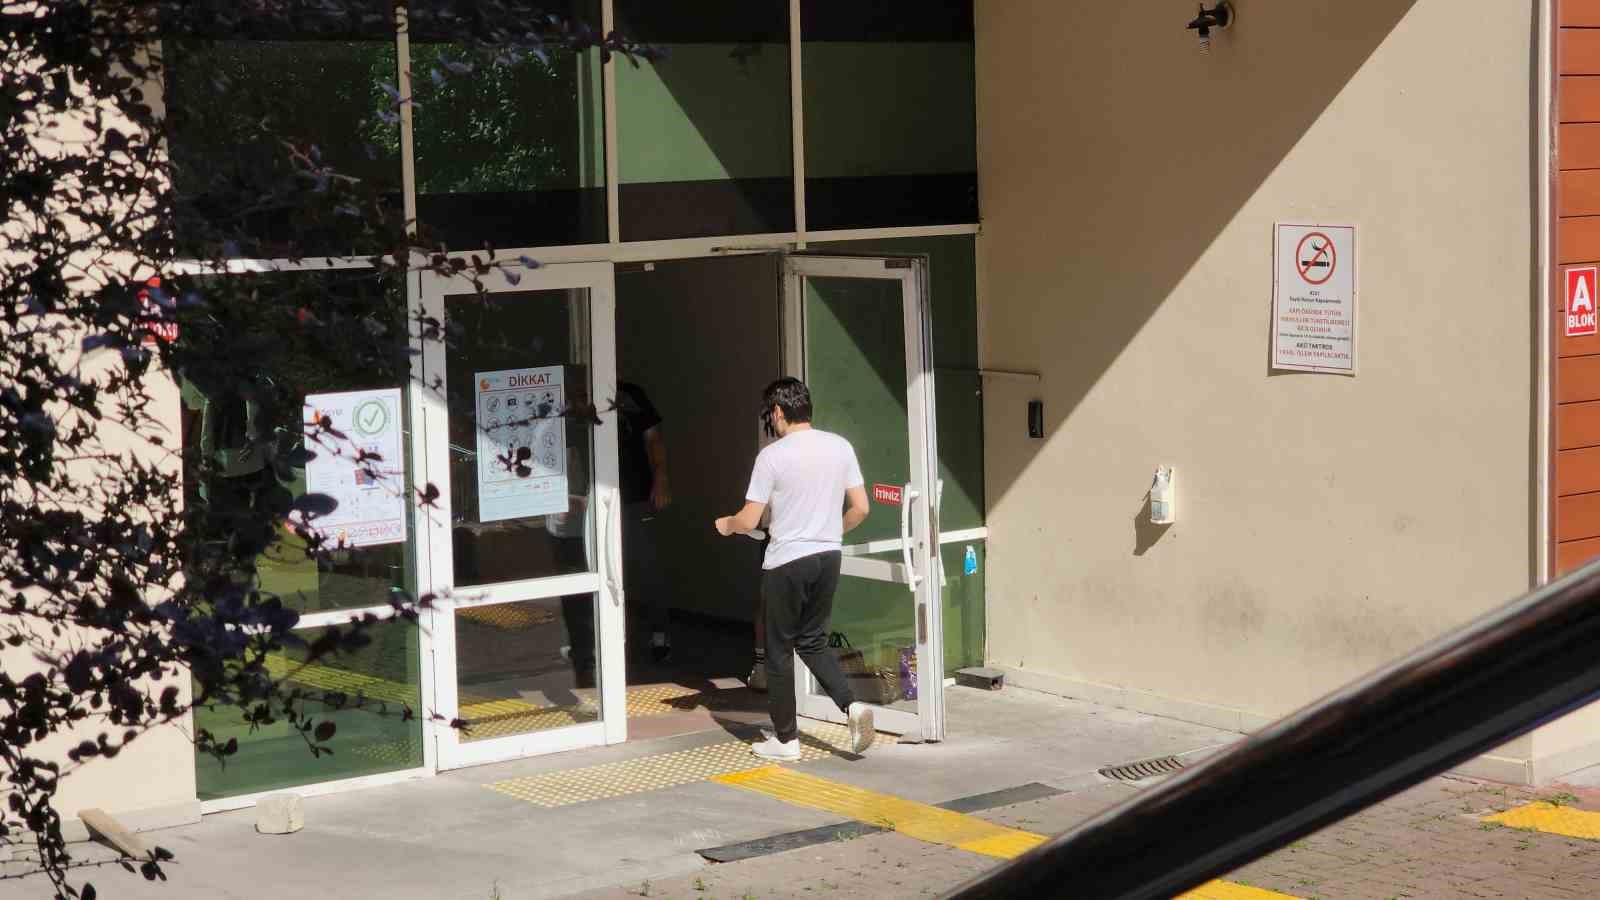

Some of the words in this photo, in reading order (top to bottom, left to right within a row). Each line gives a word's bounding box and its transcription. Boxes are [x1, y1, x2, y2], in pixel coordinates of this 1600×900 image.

[1572, 275, 1592, 312] A
[1568, 313, 1595, 328] BLOK
[509, 373, 552, 387] DİKKAT
[875, 487, 900, 502] İTİNİZ
